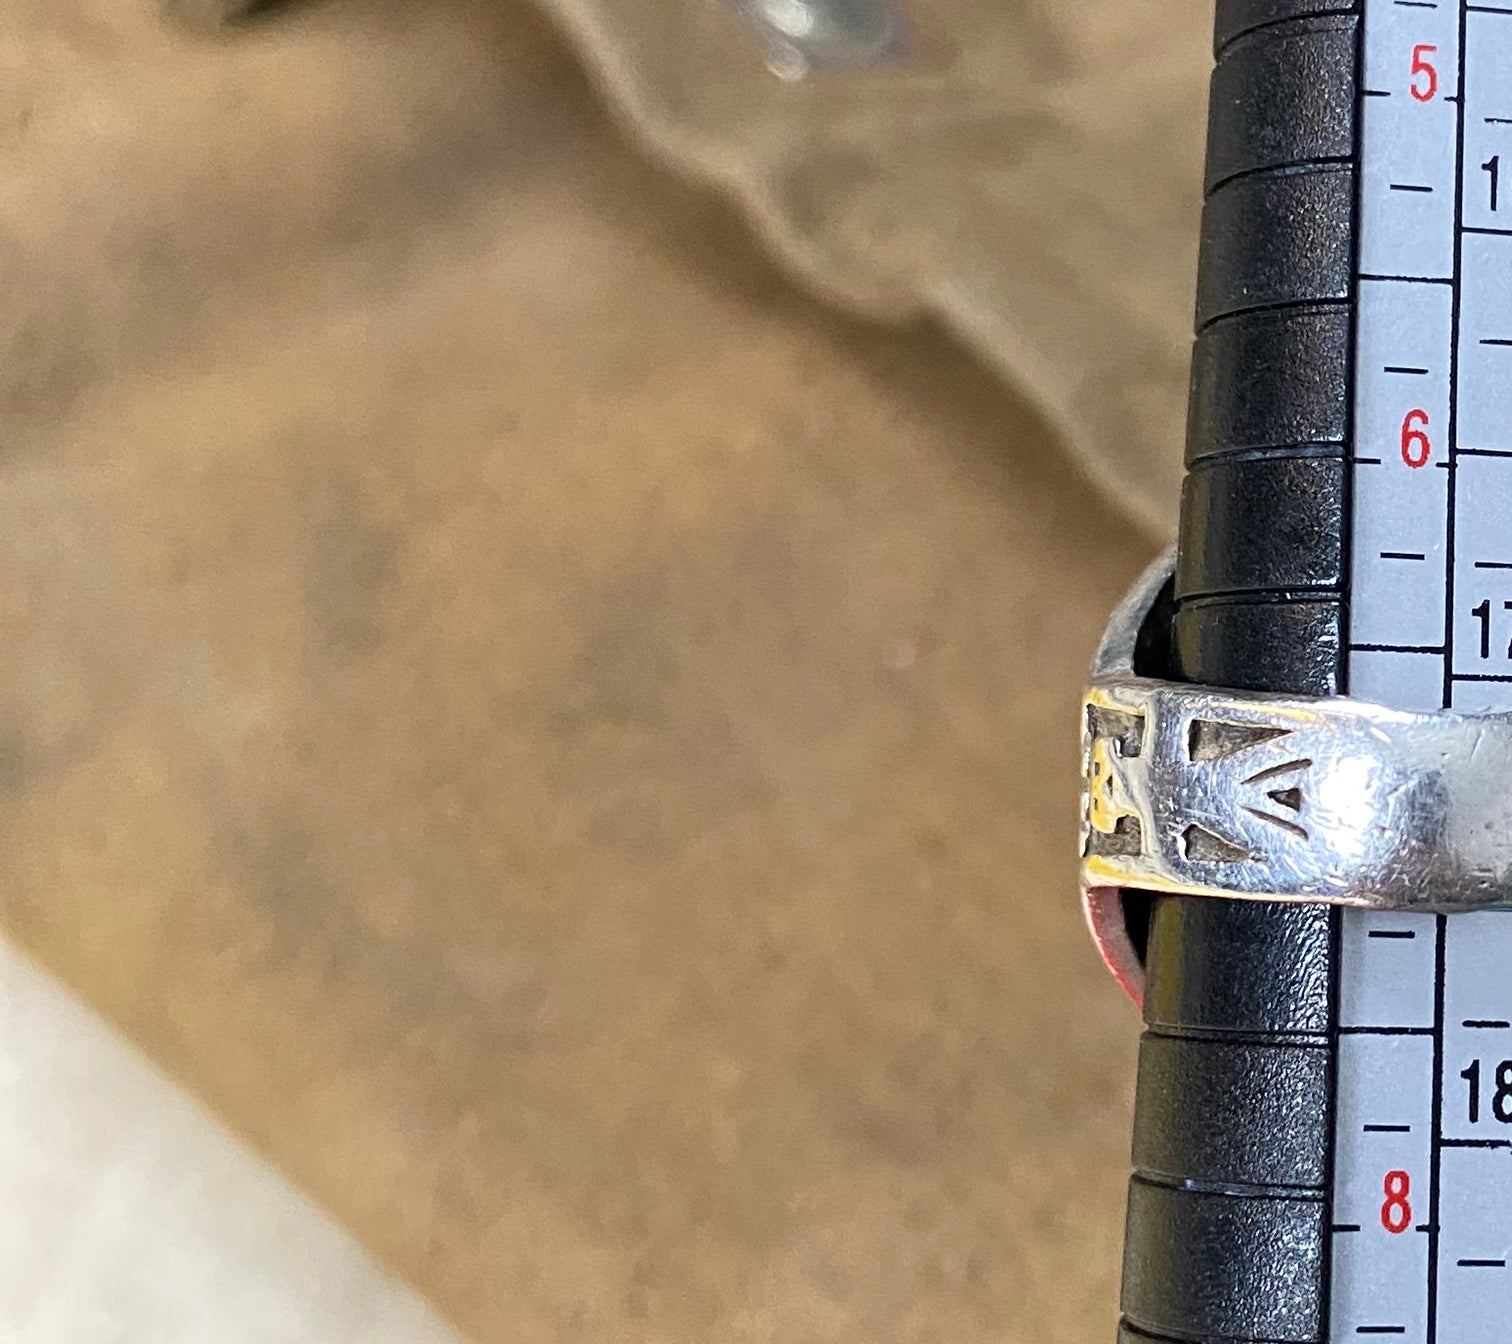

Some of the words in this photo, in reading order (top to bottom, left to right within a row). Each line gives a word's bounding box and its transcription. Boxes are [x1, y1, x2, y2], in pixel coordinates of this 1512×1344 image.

[1410, 45, 1437, 101] 5
[1401, 410, 1431, 469] 6
[1381, 1171, 1411, 1234] 8
